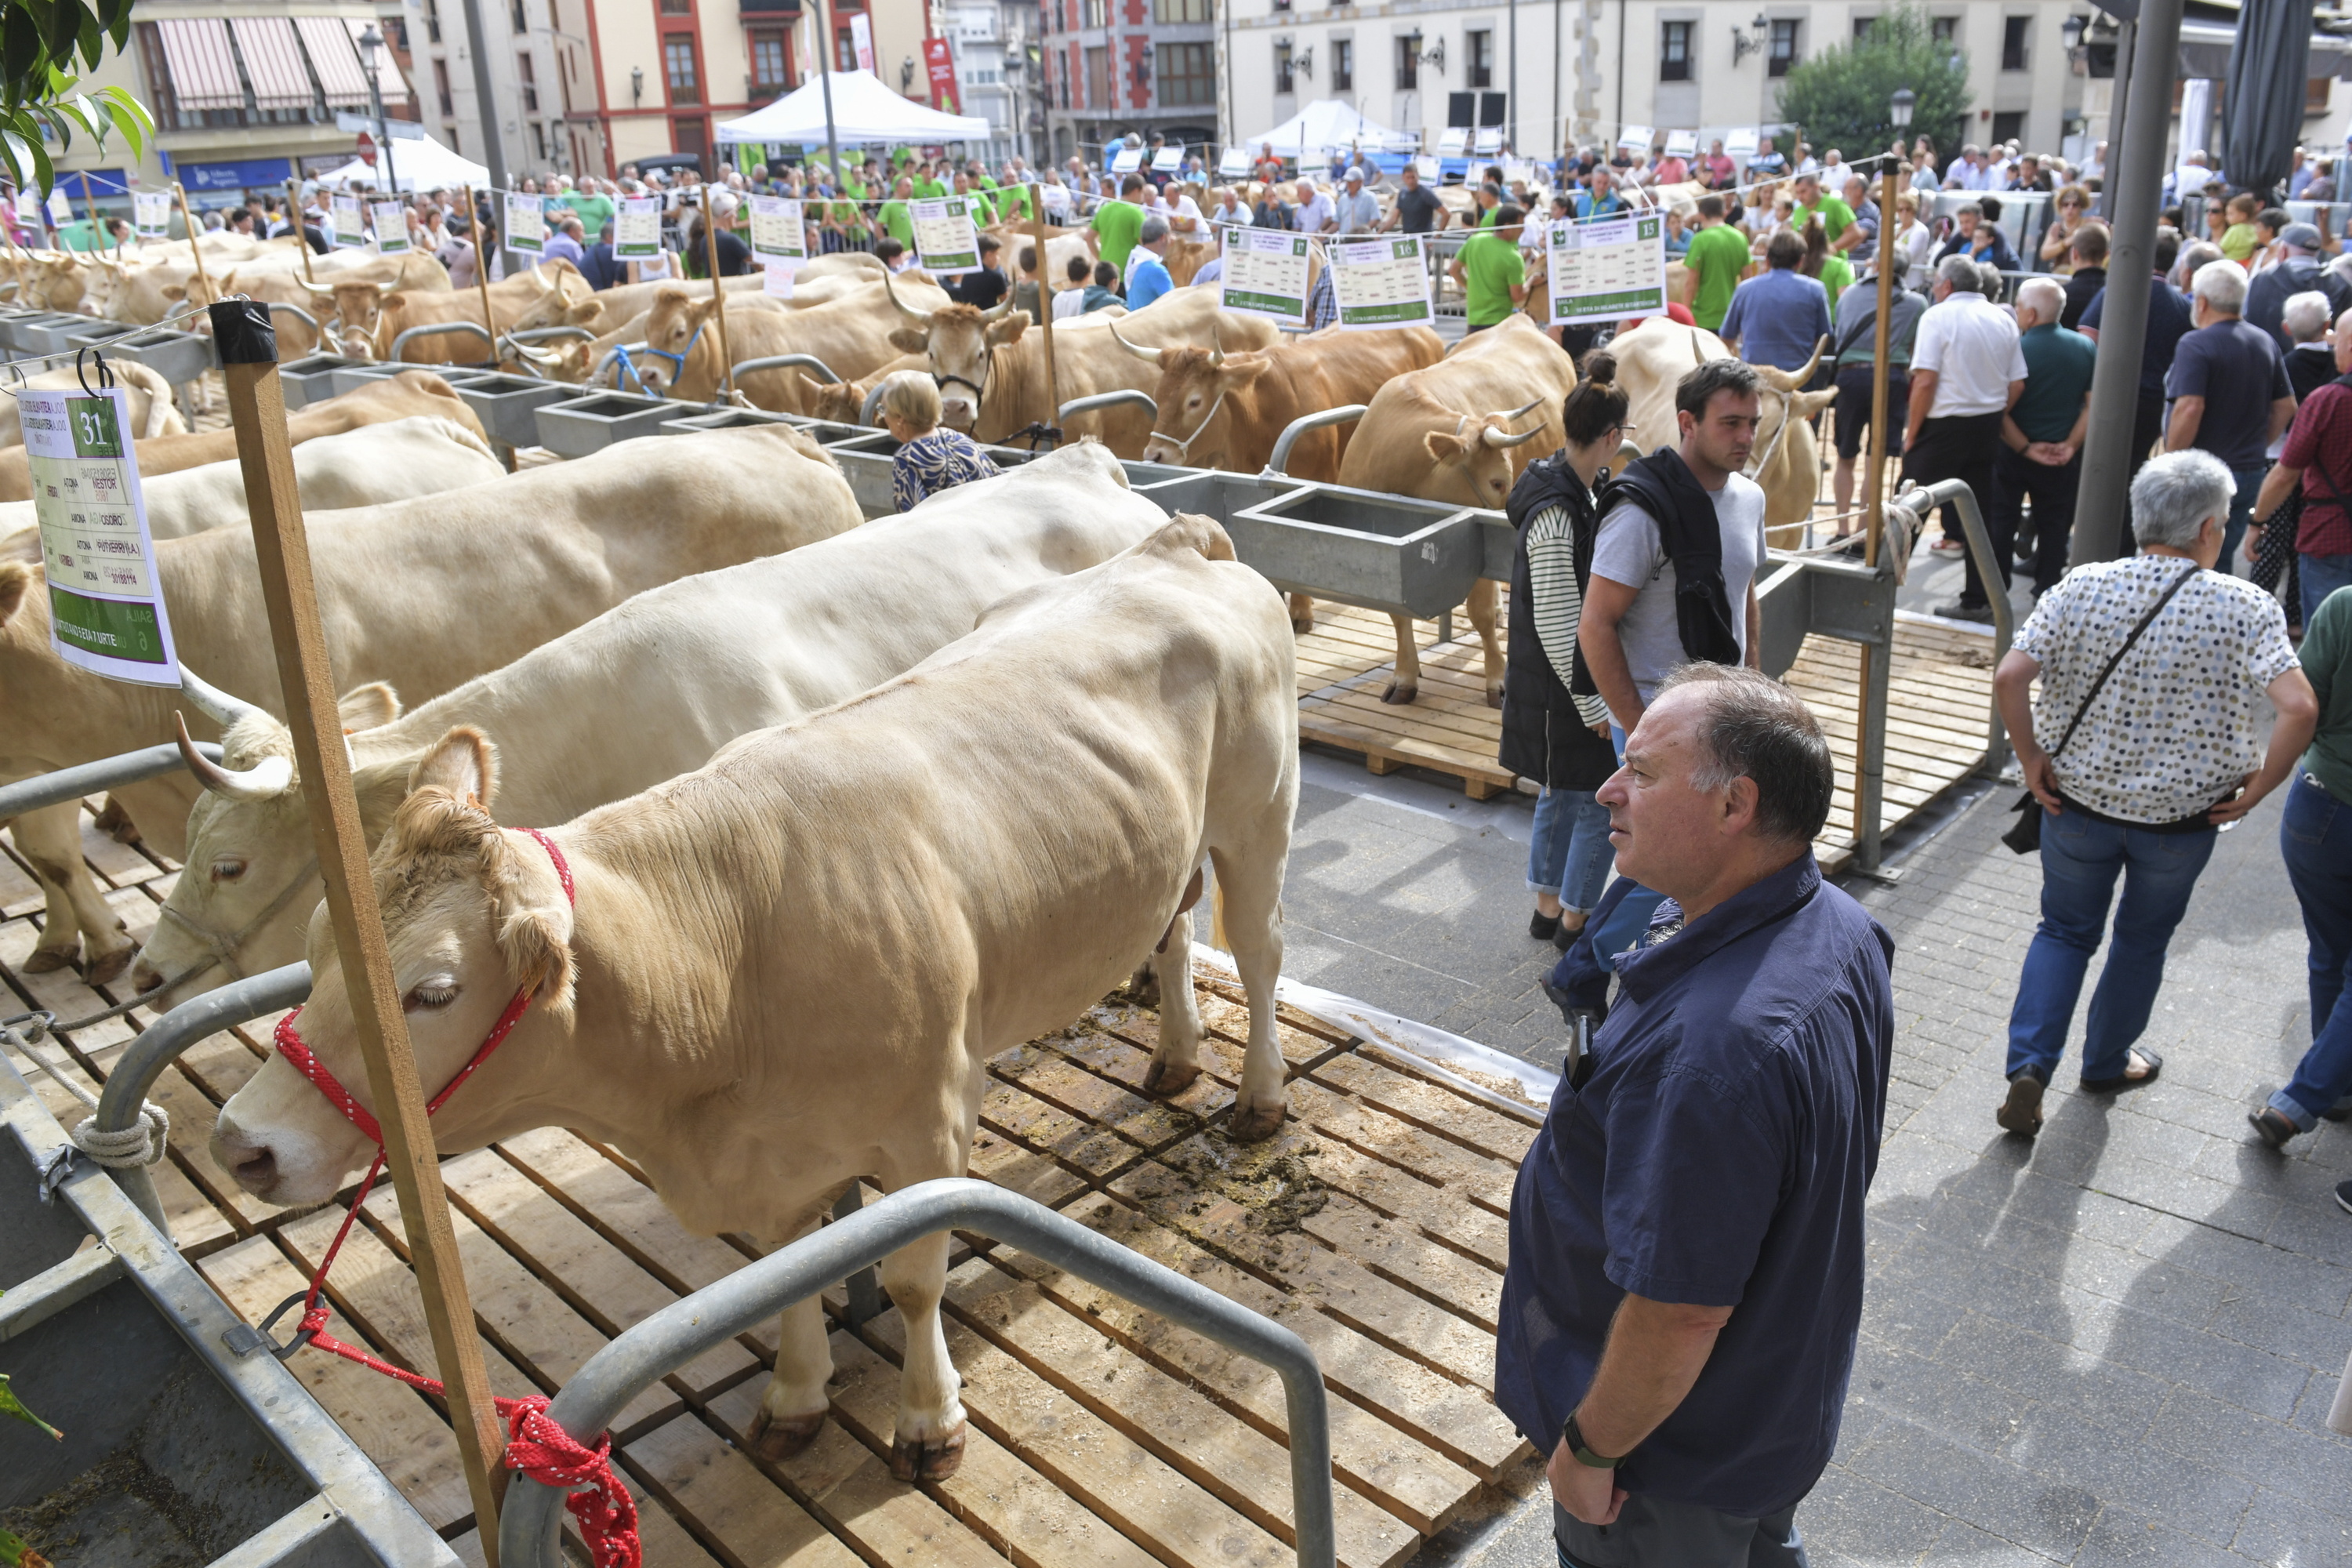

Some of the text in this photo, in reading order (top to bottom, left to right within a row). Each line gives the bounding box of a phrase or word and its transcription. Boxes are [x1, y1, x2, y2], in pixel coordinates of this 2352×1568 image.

[1642, 223, 1655, 237] 15
[1399, 244, 1413, 256] 16
[1563, 306, 1569, 314] 3
[80, 412, 107, 445] 31
[93, 478, 118, 490] NESTOR
[101, 514, 123, 526] OSORO
[82, 628, 93, 642] ETA
[92, 631, 97, 643] 7
[97, 633, 118, 647] URTE
